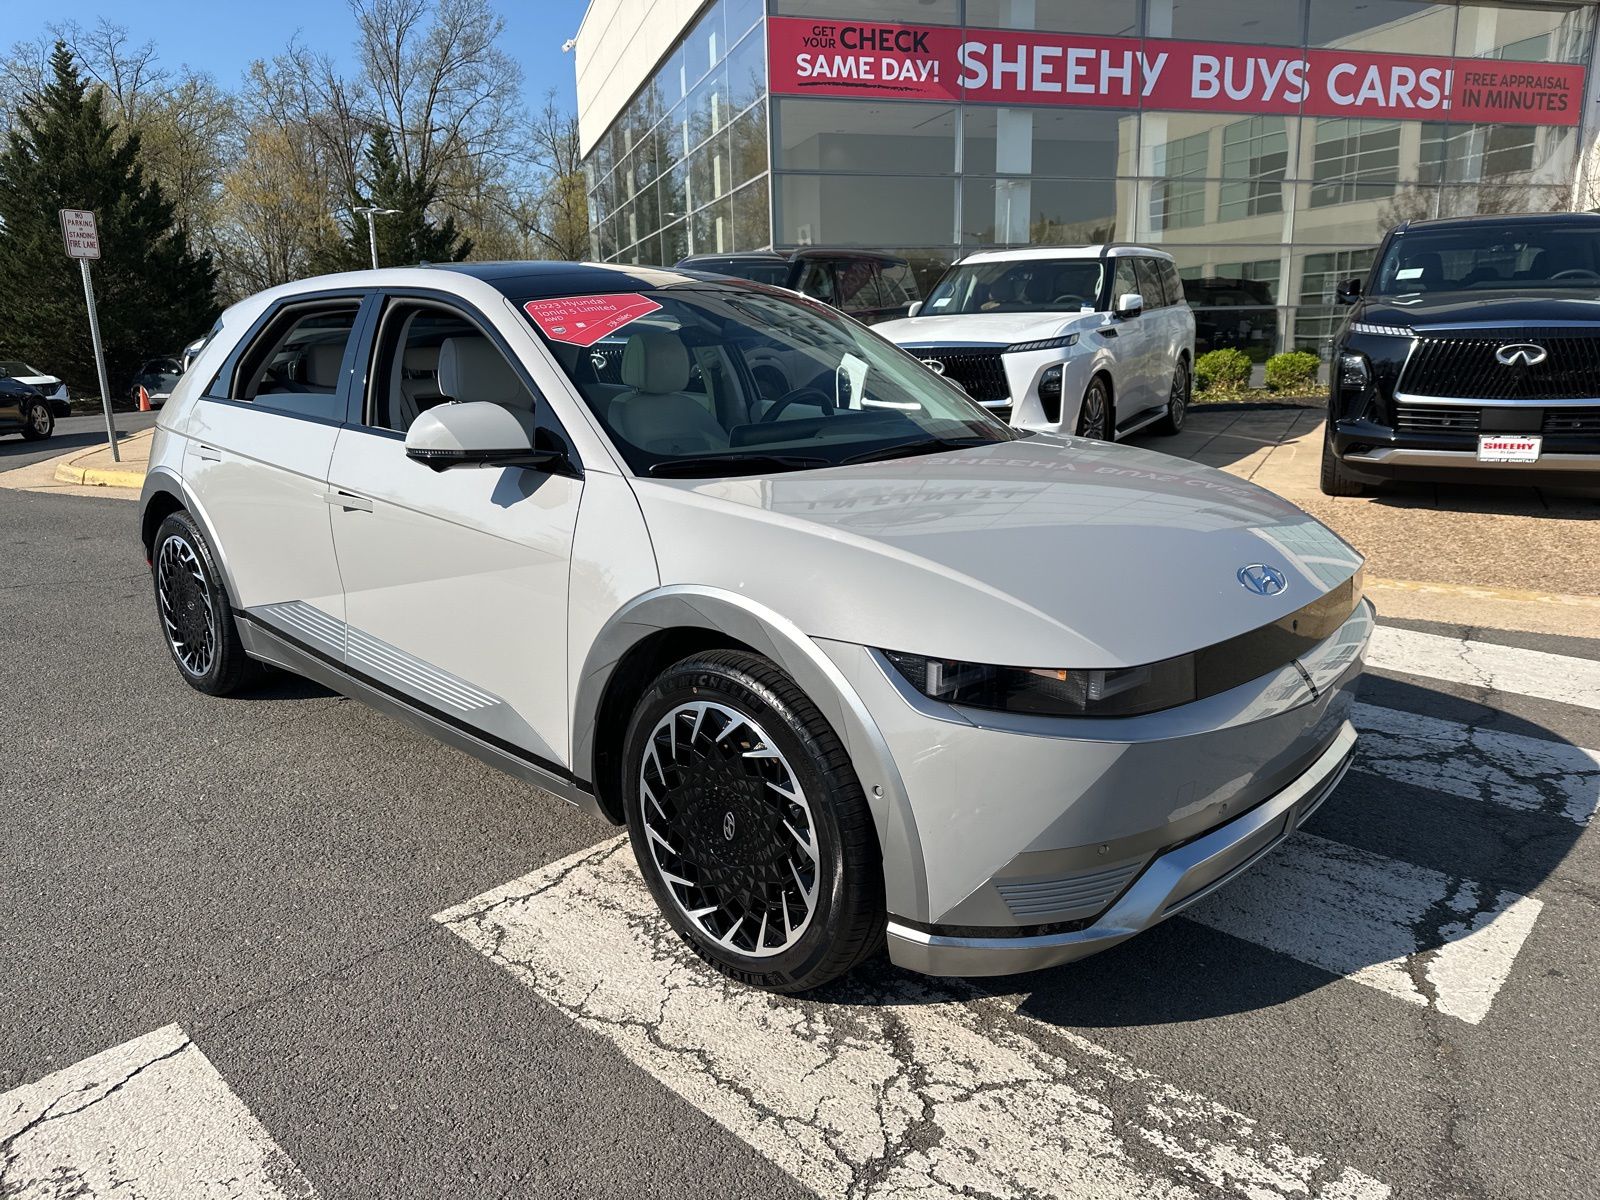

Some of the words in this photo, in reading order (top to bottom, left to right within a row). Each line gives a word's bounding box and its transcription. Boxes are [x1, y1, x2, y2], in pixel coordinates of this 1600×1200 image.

[812, 26, 836, 37] GET
[840, 27, 930, 53] CHECK
[803, 37, 836, 48] YOUR
[796, 53, 875, 80] SAME
[882, 57, 939, 83] DAY!
[956, 41, 1168, 97] SHEEHY
[1191, 55, 1311, 103] BUYS
[1326, 63, 1455, 110] CARS!
[1464, 72, 1497, 87] FREE
[1501, 75, 1569, 90] APPRAISAL
[1462, 89, 1481, 108] IN
[1484, 90, 1568, 111] MINUTES
[537, 309, 568, 317] Ioniq
[577, 305, 617, 313] Limited
[562, 299, 606, 308] Hyundai
